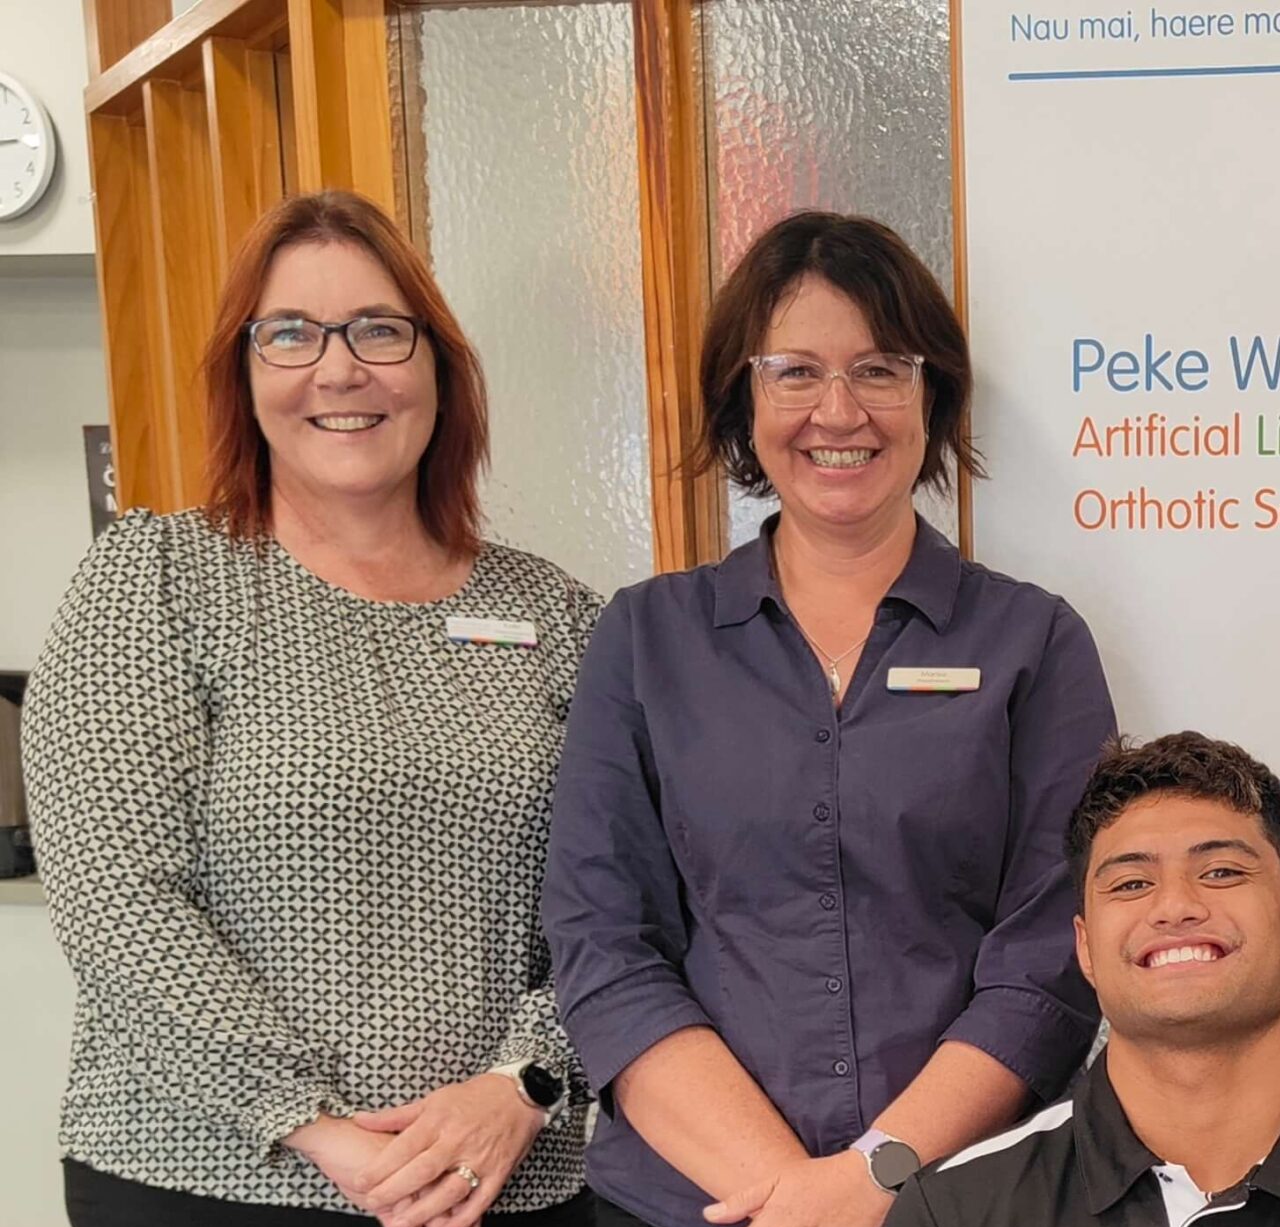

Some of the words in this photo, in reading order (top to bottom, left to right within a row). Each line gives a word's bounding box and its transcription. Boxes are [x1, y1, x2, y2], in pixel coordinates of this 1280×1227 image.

[1012, 14, 1068, 41] Nau
[1080, 11, 1139, 42] mai,
[1152, 8, 1234, 37] haere
[21, 107, 31, 125] 2
[14, 181, 23, 198] 5
[1073, 334, 1209, 392] Peke
[1073, 412, 1240, 458] Artificial
[1074, 487, 1240, 530] Orthotic
